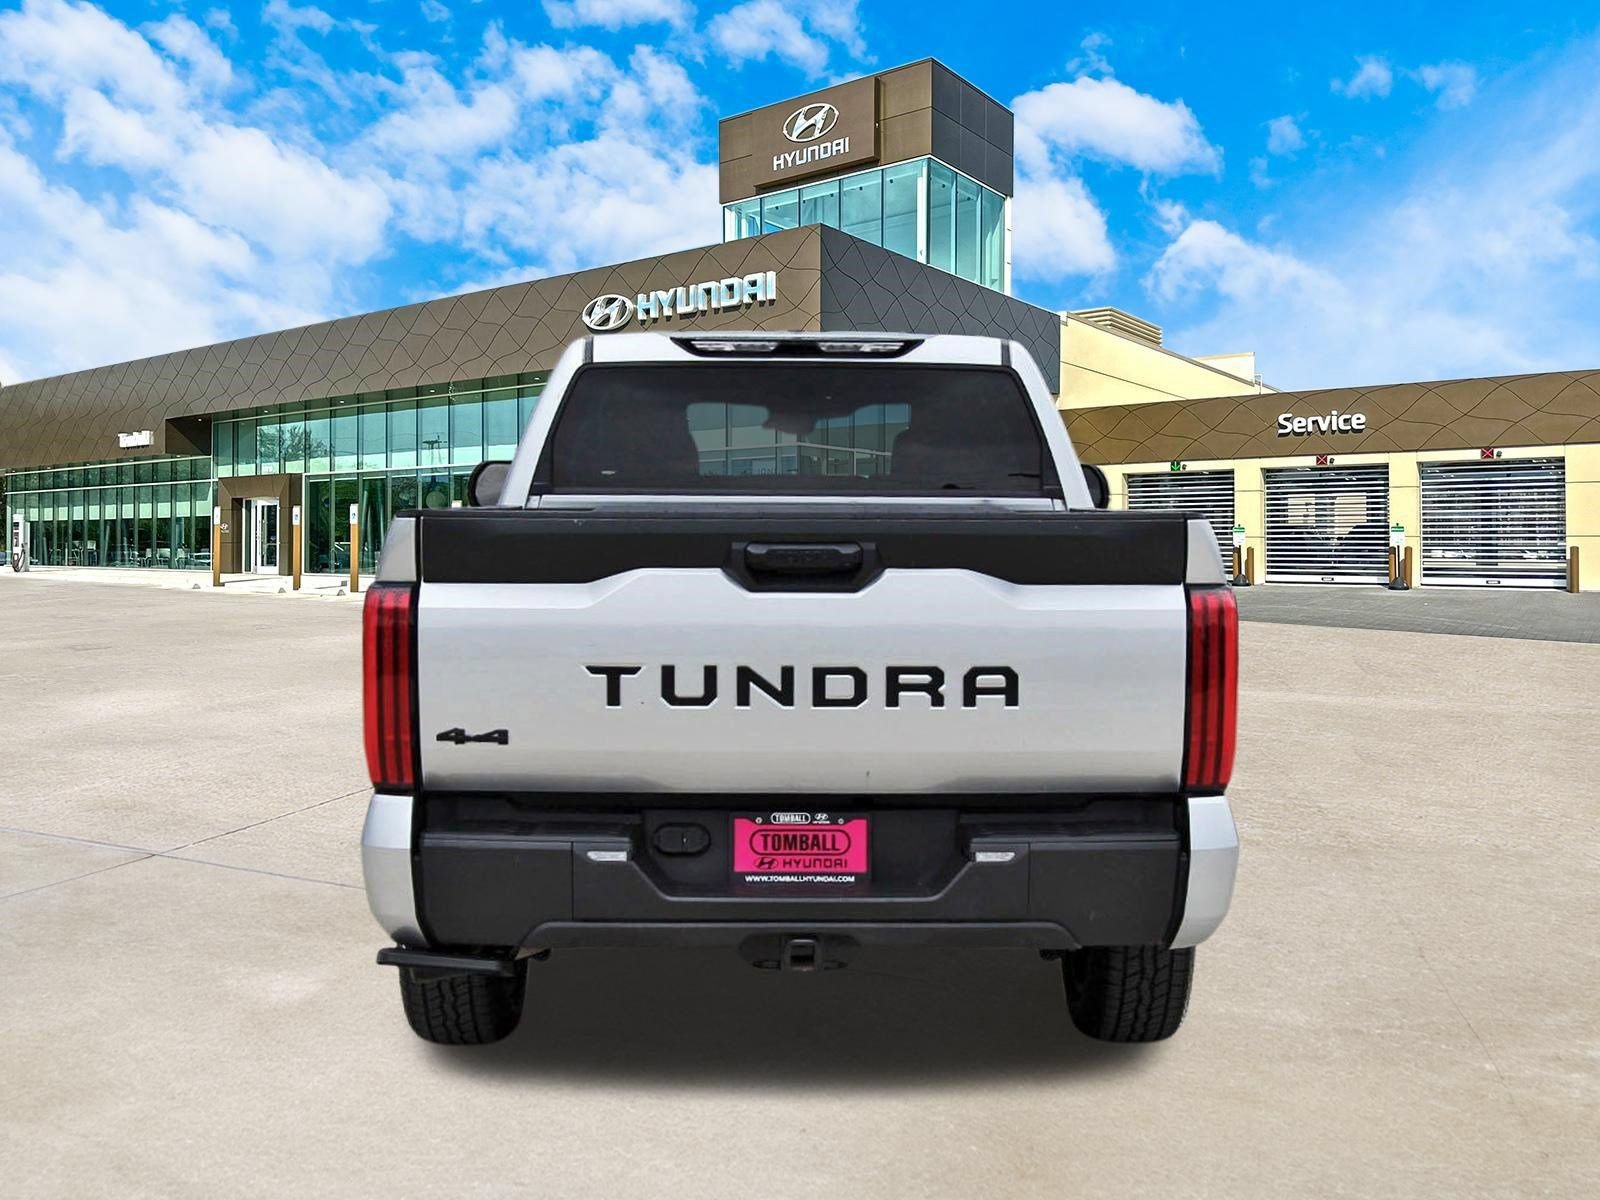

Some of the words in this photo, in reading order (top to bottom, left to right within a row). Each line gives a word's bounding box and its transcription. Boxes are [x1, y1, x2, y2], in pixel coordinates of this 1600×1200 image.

[773, 137, 850, 171] HYUNDAI
[637, 271, 777, 321] HYUNDAI
[1278, 410, 1366, 434] Service
[585, 664, 1020, 709] TUNDRA
[760, 833, 842, 852] TOMBALL
[782, 858, 848, 869] HYUNDAI
